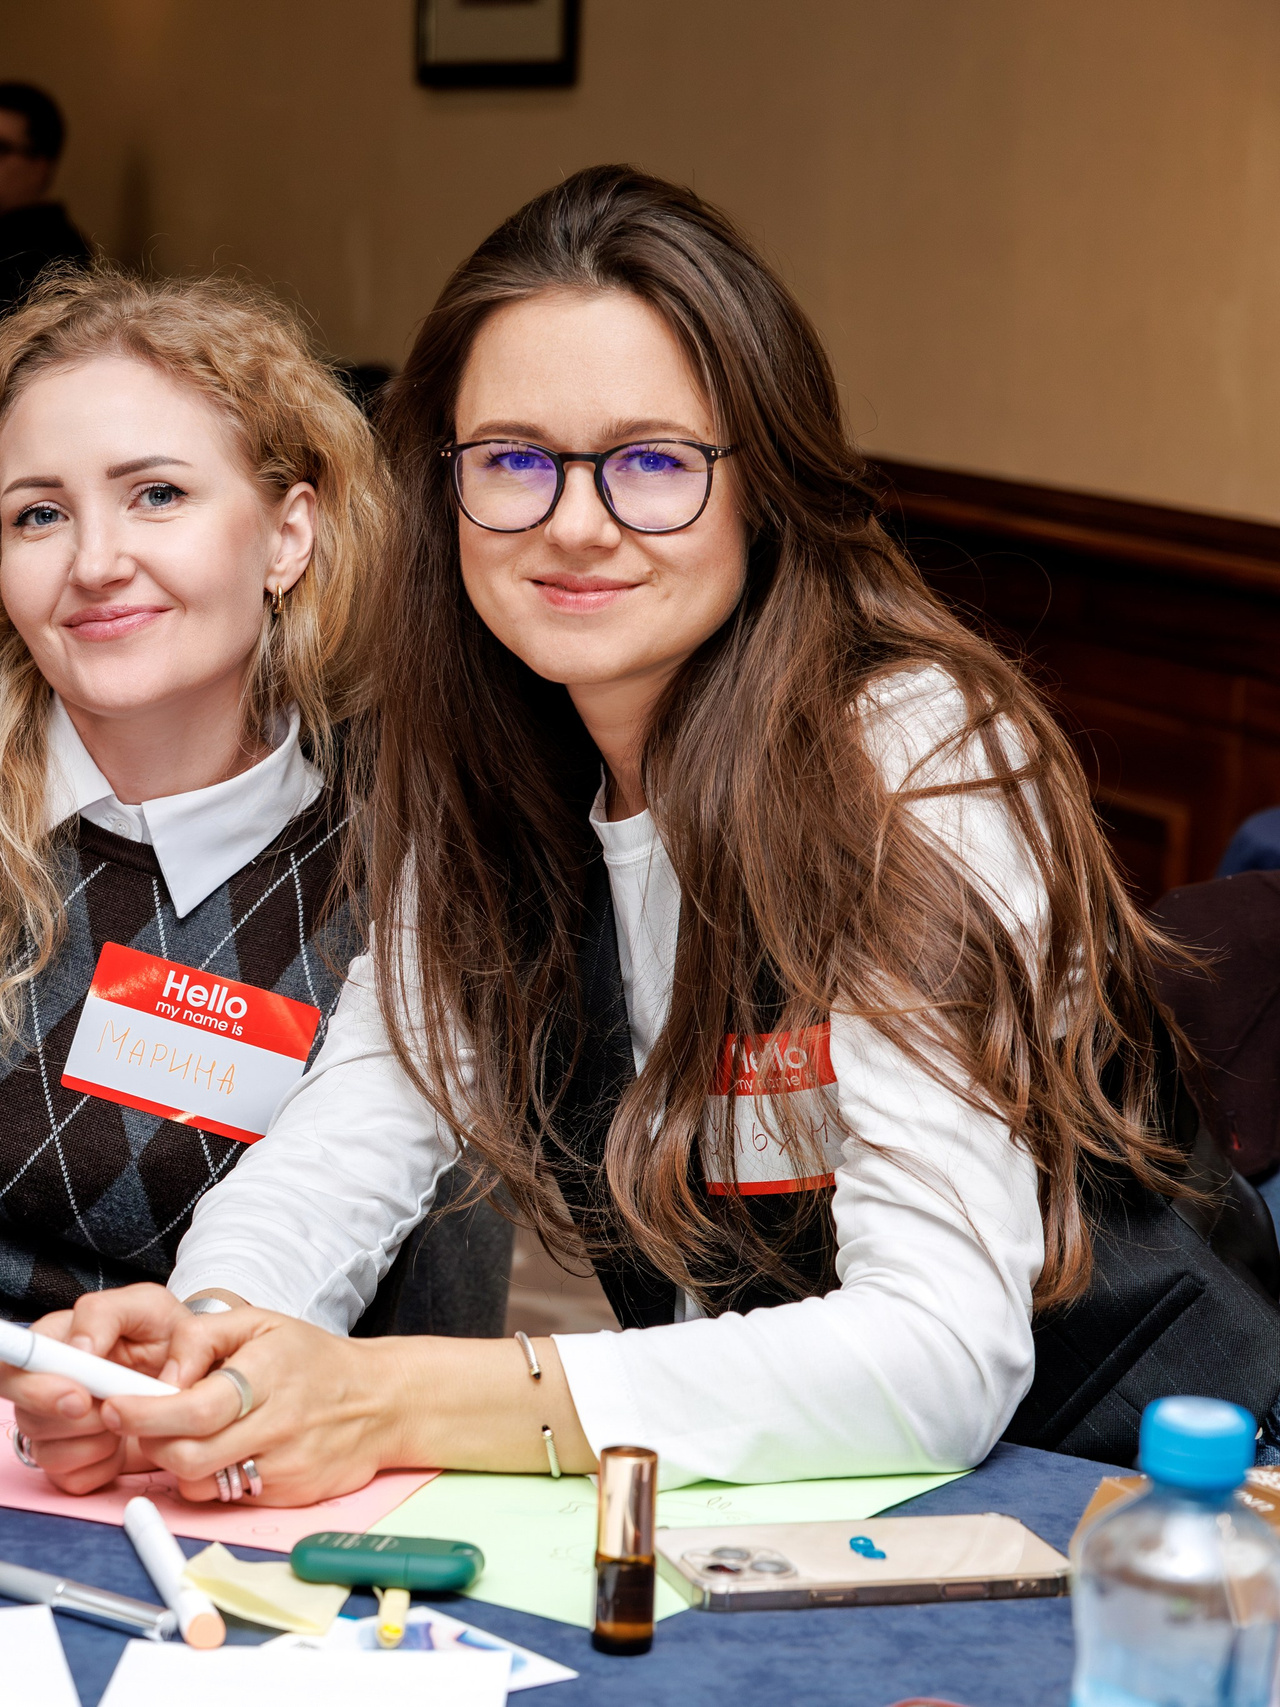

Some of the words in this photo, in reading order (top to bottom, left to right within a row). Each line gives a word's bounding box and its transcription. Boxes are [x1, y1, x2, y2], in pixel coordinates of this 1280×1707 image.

[155, 1000, 180, 1018] my
[183, 1006, 228, 1032] name
[231, 1021, 243, 1036] is
[162, 970, 248, 1019] Hello
[97, 1019, 236, 1095] МАРИНА
